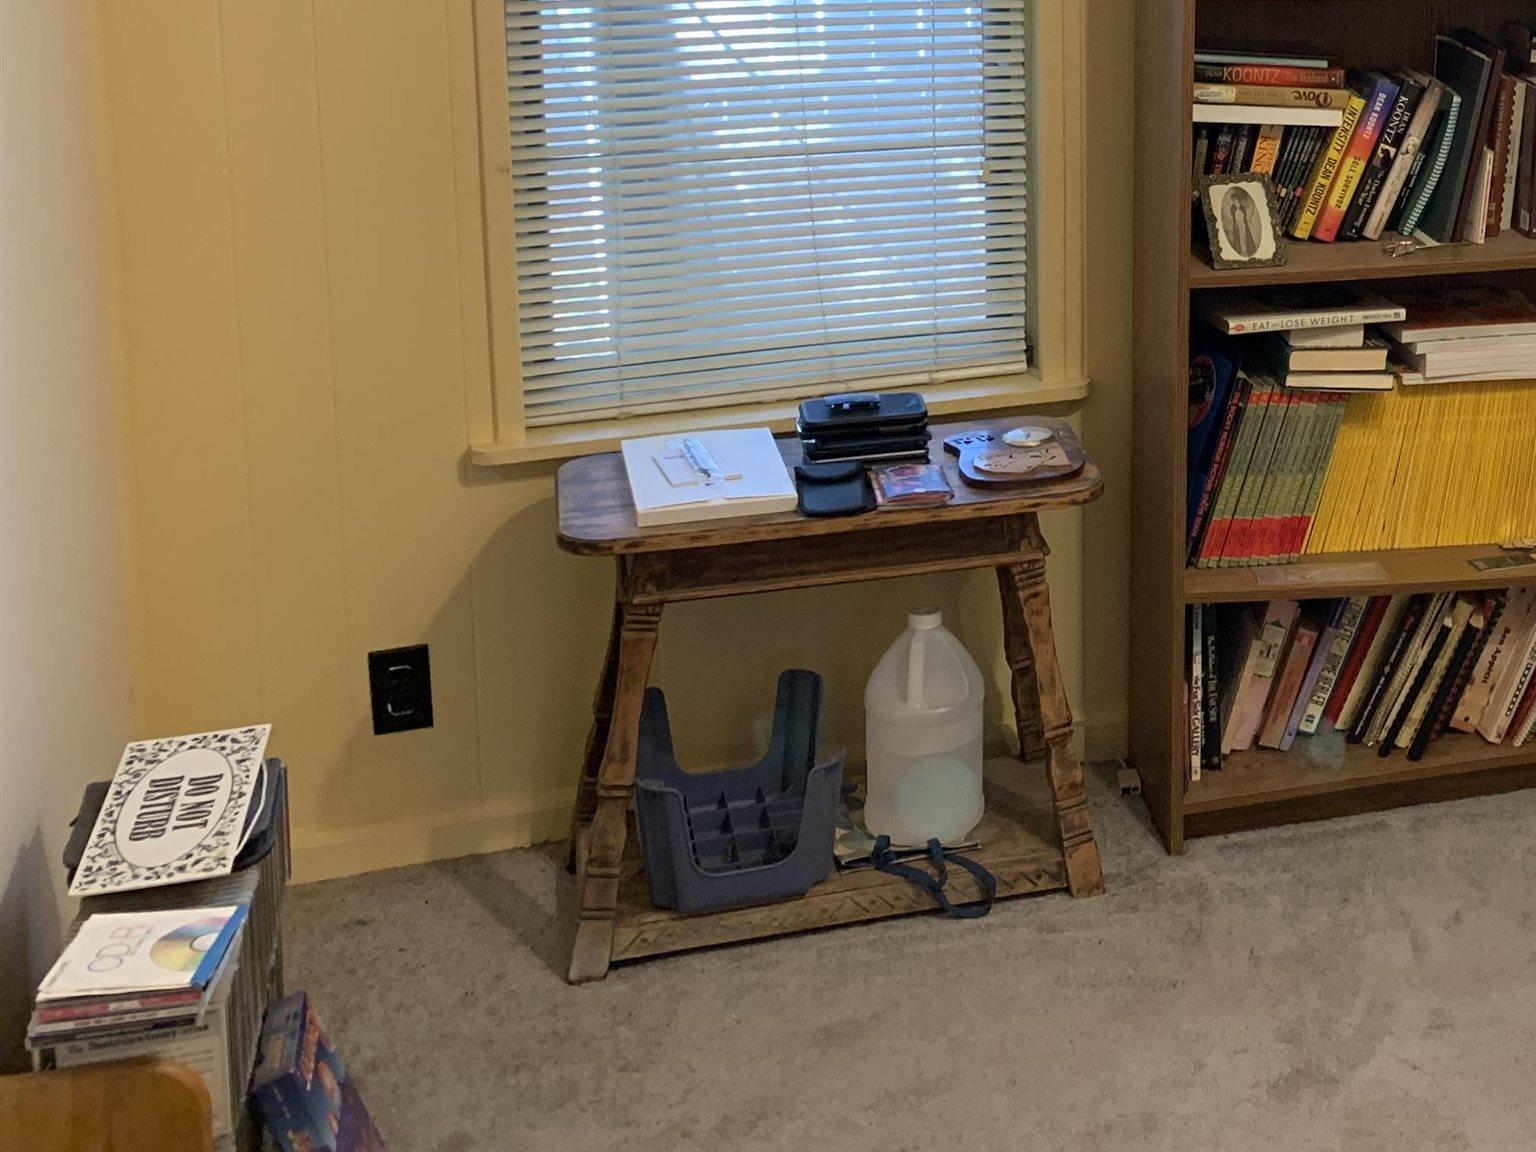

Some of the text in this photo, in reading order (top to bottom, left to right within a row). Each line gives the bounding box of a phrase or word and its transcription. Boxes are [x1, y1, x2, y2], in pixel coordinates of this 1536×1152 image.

[1222, 66, 1281, 84] KOONTZ
[1362, 92, 1387, 140] DEAN KOONTZ
[1382, 95, 1409, 144] KOONTZ
[1396, 110, 1412, 135] DEAN
[1305, 105, 1359, 217] INTENSITY DEAN KOONTZ
[1335, 156, 1361, 210] SOLE SURVIVOR
[1251, 314, 1355, 331] EAT LOSE WEIGHT
[1190, 717, 1202, 756] GALLERY
[128, 774, 186, 843] DISTURB
[171, 772, 224, 832] DO NOT
